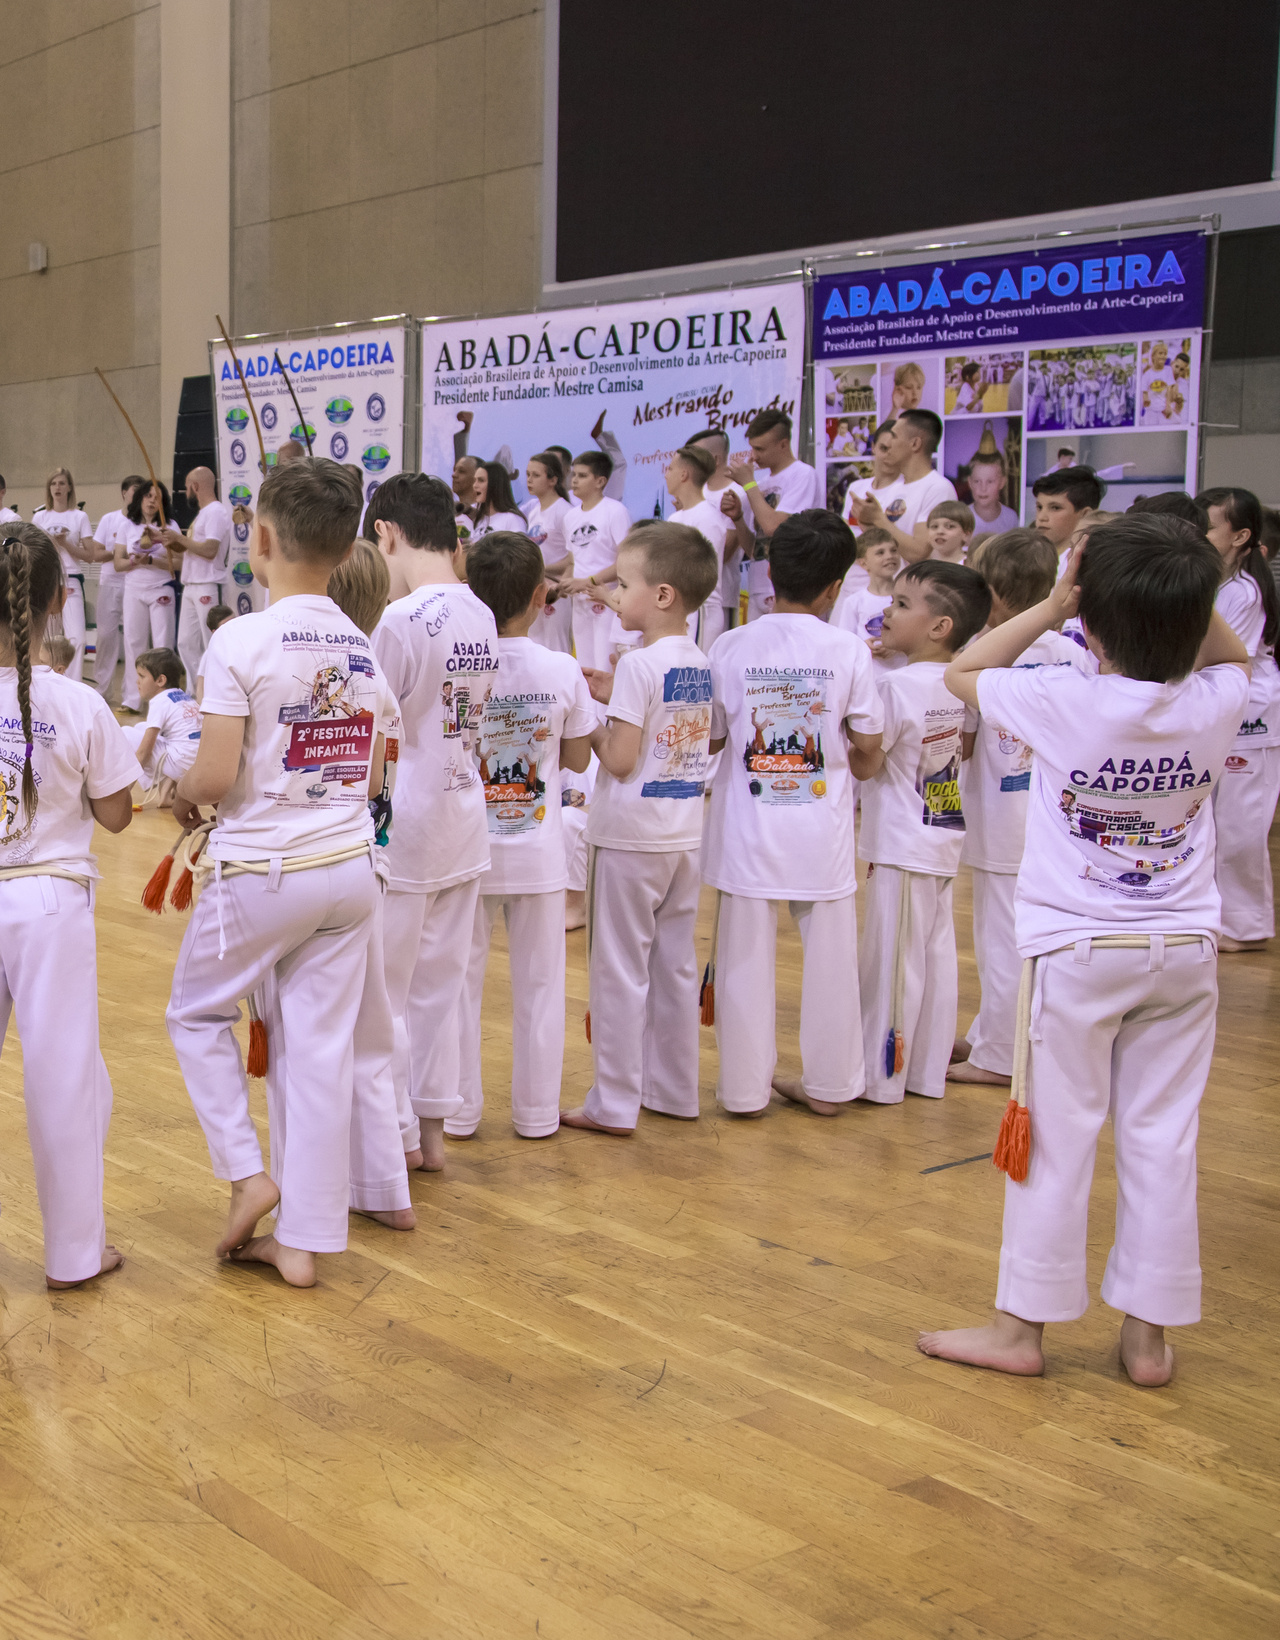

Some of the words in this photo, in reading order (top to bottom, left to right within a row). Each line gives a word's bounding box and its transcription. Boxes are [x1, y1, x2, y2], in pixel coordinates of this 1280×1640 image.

[822, 249, 1186, 321] ABADÁ-CAPOEIRA
[823, 322, 875, 336] Associação
[877, 317, 925, 331] Brasileira
[926, 315, 939, 326] de
[941, 312, 974, 327] Apoio
[976, 313, 983, 321] e
[985, 300, 1081, 320] Desenvolvimento
[1084, 299, 1098, 310] da
[1101, 291, 1184, 309] Arte-Capoeira
[434, 306, 787, 373] ABADÁ-CAPOEIRA
[823, 338, 876, 352] Presidente
[879, 333, 933, 347] Fundador:
[936, 330, 974, 343] Mestre
[976, 324, 1019, 339] Camisa
[221, 340, 395, 382] ABADÁ-CAPOEIRA
[434, 373, 483, 388] Associação
[485, 368, 531, 383] Brasileira
[533, 366, 546, 379] de
[548, 363, 579, 381] Apoio
[581, 367, 587, 376] e
[590, 356, 684, 375] Desenvolvimento
[687, 352, 700, 366] da
[704, 345, 787, 366] Arte-Capoeira
[297, 385, 317, 394] Camisa
[434, 387, 490, 406] Presidente
[492, 383, 550, 401] Fundador:
[553, 380, 595, 397] Mestre
[598, 375, 644, 394] Camisa
[633, 384, 734, 426] Mestrando
[453, 638, 490, 656] ABADÁ
[744, 666, 835, 678] ABADÁ-CAPOEIRA
[487, 693, 557, 704] DÁ-CAPOEIRA
[297, 727, 311, 742] 2º
[312, 725, 370, 741] FESTIVAL
[303, 743, 359, 759] INFANTIL
[1098, 751, 1193, 775] ABADÁ
[9, 751, 44, 788] INFTIL
[757, 755, 816, 772] Batizado
[1070, 769, 1212, 793] CAPOEIRA
[1075, 808, 1142, 823] MESTRANDO
[1108, 820, 1156, 831] CASCÃO
